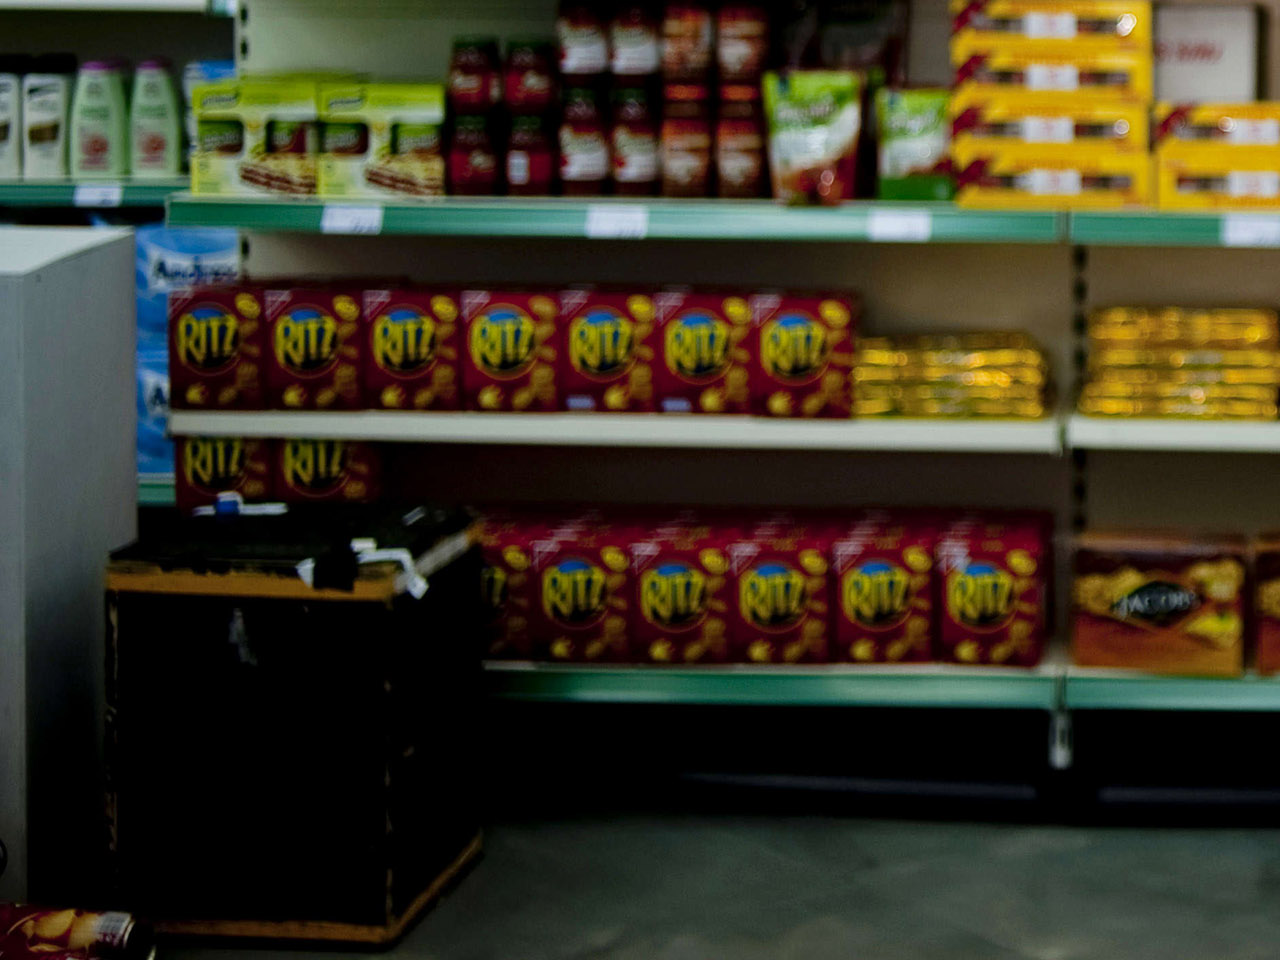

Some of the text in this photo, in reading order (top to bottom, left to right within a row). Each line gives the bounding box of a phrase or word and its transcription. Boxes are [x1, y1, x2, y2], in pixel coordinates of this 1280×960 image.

[176, 312, 239, 369] RITZ
[272, 314, 336, 370] RITZ
[371, 313, 436, 371] RITZ
[470, 315, 536, 370] RITZ
[183, 440, 243, 484] RITZ
[282, 440, 343, 487] RITZ
[541, 566, 606, 617] RITZ
